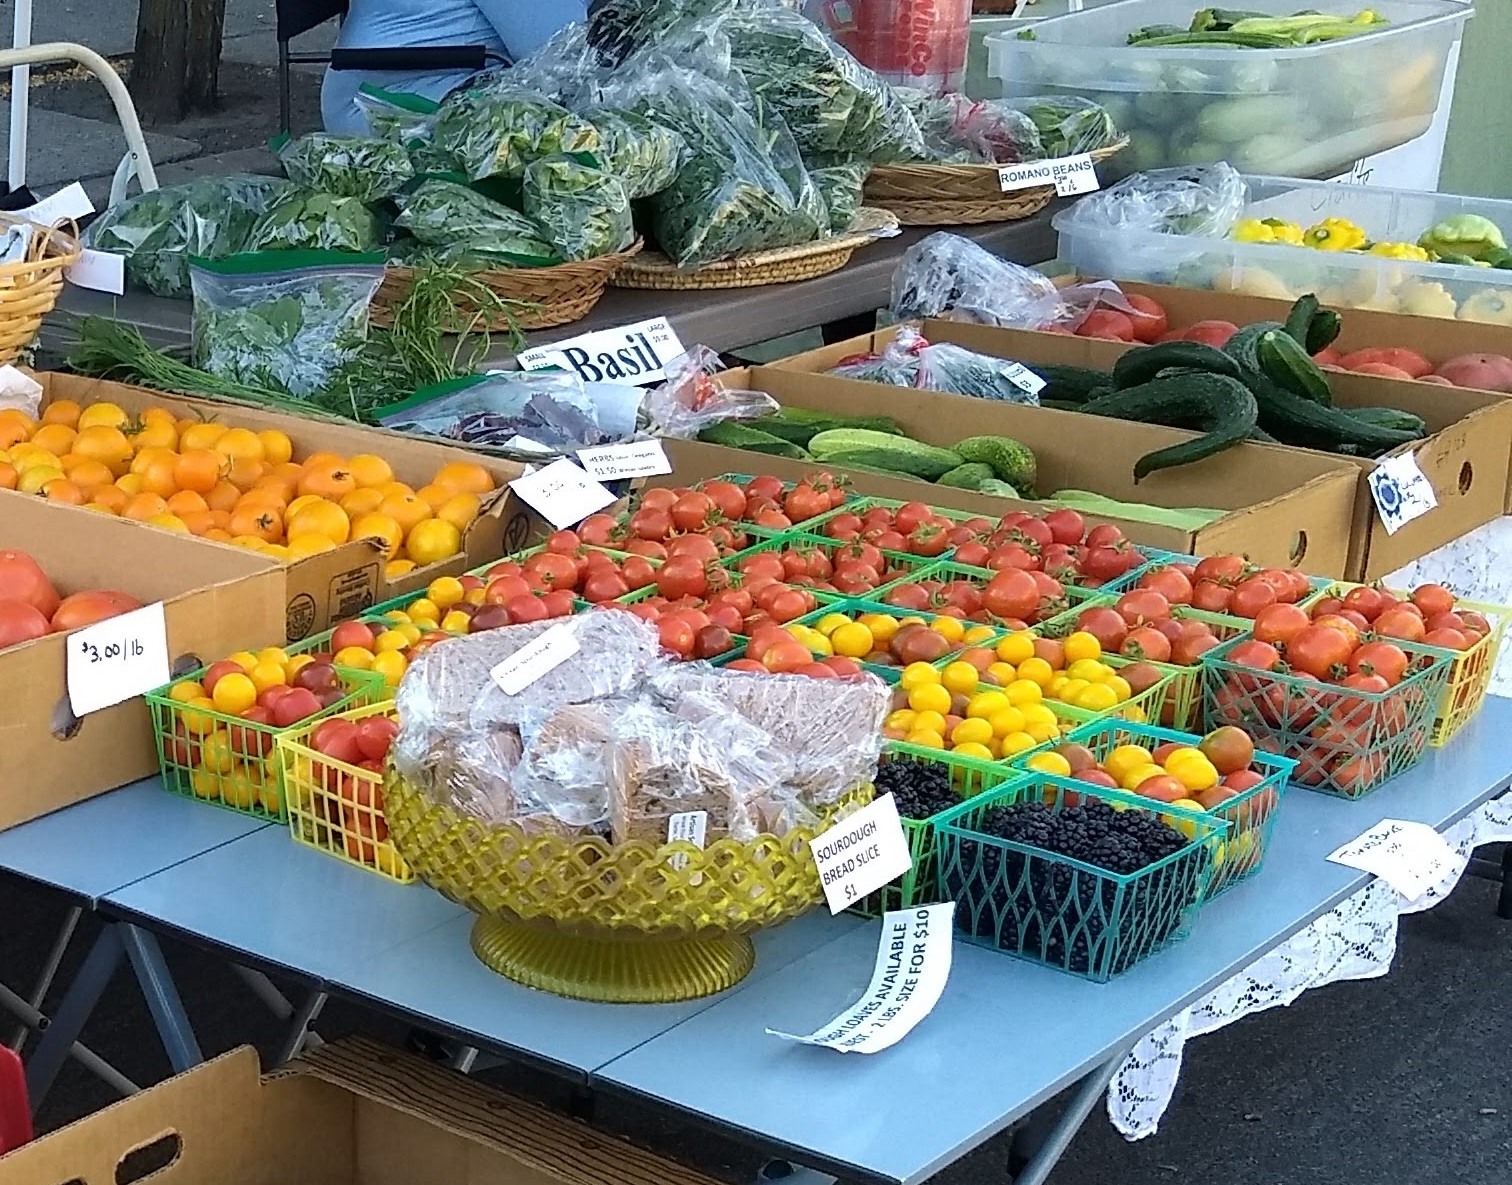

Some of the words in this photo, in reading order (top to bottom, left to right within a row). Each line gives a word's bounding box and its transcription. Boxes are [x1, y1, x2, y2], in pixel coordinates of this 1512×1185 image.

[1000, 167, 1050, 183] ROMANO
[1052, 160, 1092, 175] BEANS
[561, 332, 663, 382] Basil
[817, 820, 878, 863] SOURDOUGH
[823, 859, 855, 886] BREAD
[855, 844, 881, 867] SLICE
[844, 884, 858, 900] $1
[913, 909, 930, 938] $10
[909, 942, 926, 974] FOR
[845, 1001, 882, 1030] LOAVES
[880, 922, 907, 1000] AVAILABLE
[895, 977, 918, 1002] SIZE
